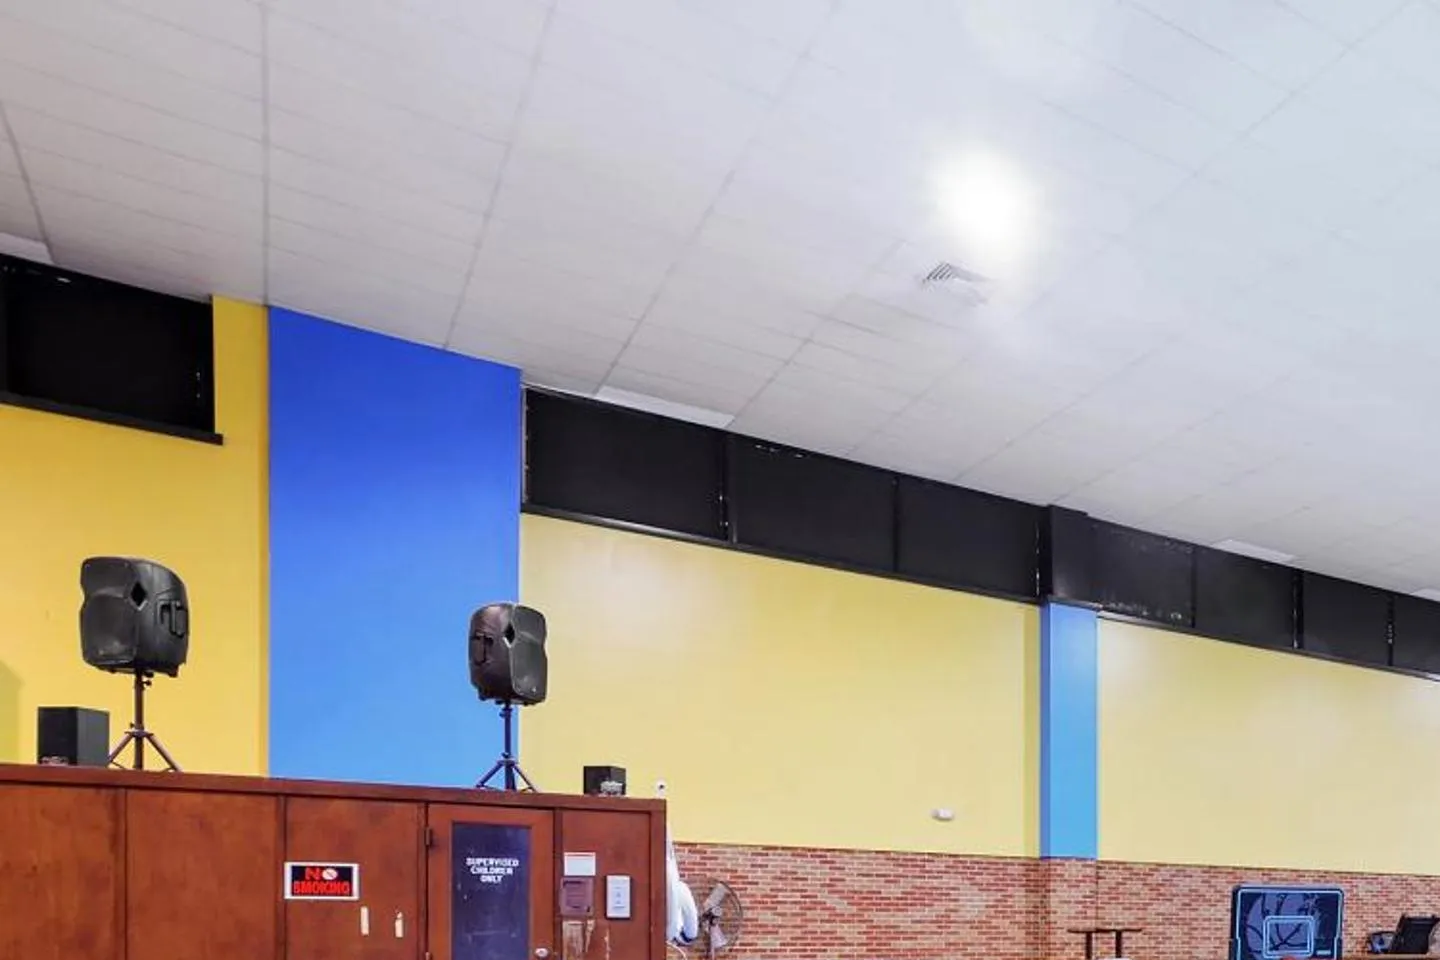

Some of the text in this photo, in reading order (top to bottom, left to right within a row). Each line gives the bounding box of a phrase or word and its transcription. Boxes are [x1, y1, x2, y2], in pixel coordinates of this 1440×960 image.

[466, 857, 519, 867] SUPERVISED
[470, 866, 513, 876] CHILDREN
[480, 875, 503, 884] ONLY
[294, 881, 350, 894] SMOKING
